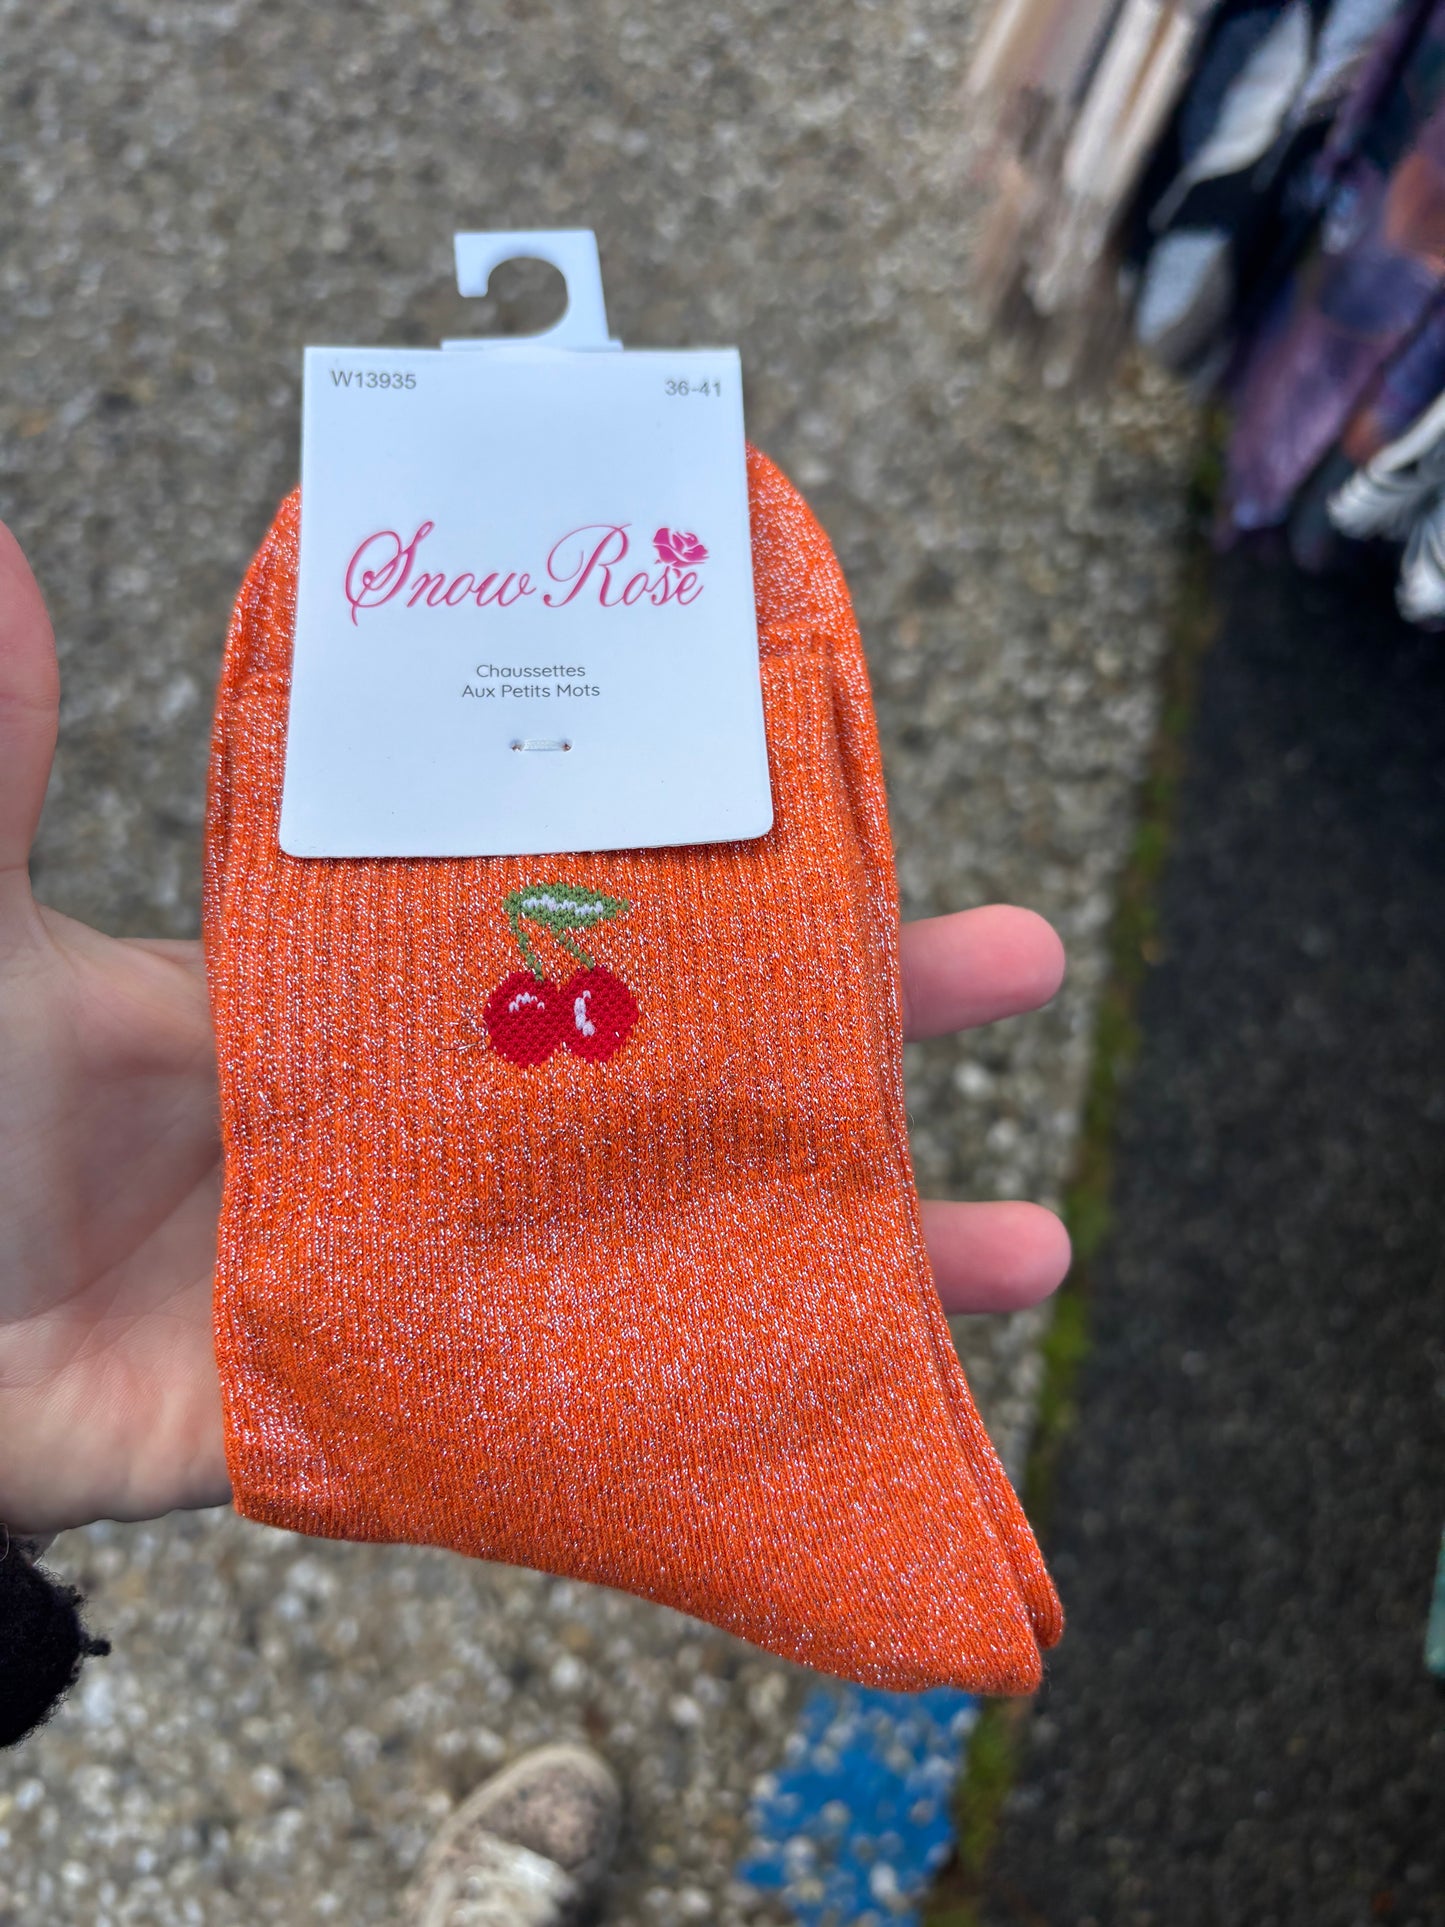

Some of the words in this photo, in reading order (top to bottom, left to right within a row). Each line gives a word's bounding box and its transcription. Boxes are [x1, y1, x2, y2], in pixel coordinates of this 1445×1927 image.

[331, 370, 417, 390] W13935
[665, 380, 721, 397] 36-41
[345, 521, 536, 626] Snow
[543, 523, 704, 607] Rose
[476, 663, 586, 678] Chaussettes
[461, 684, 496, 698] Aux
[502, 684, 552, 698] Petits
[556, 683, 601, 698] Mots
